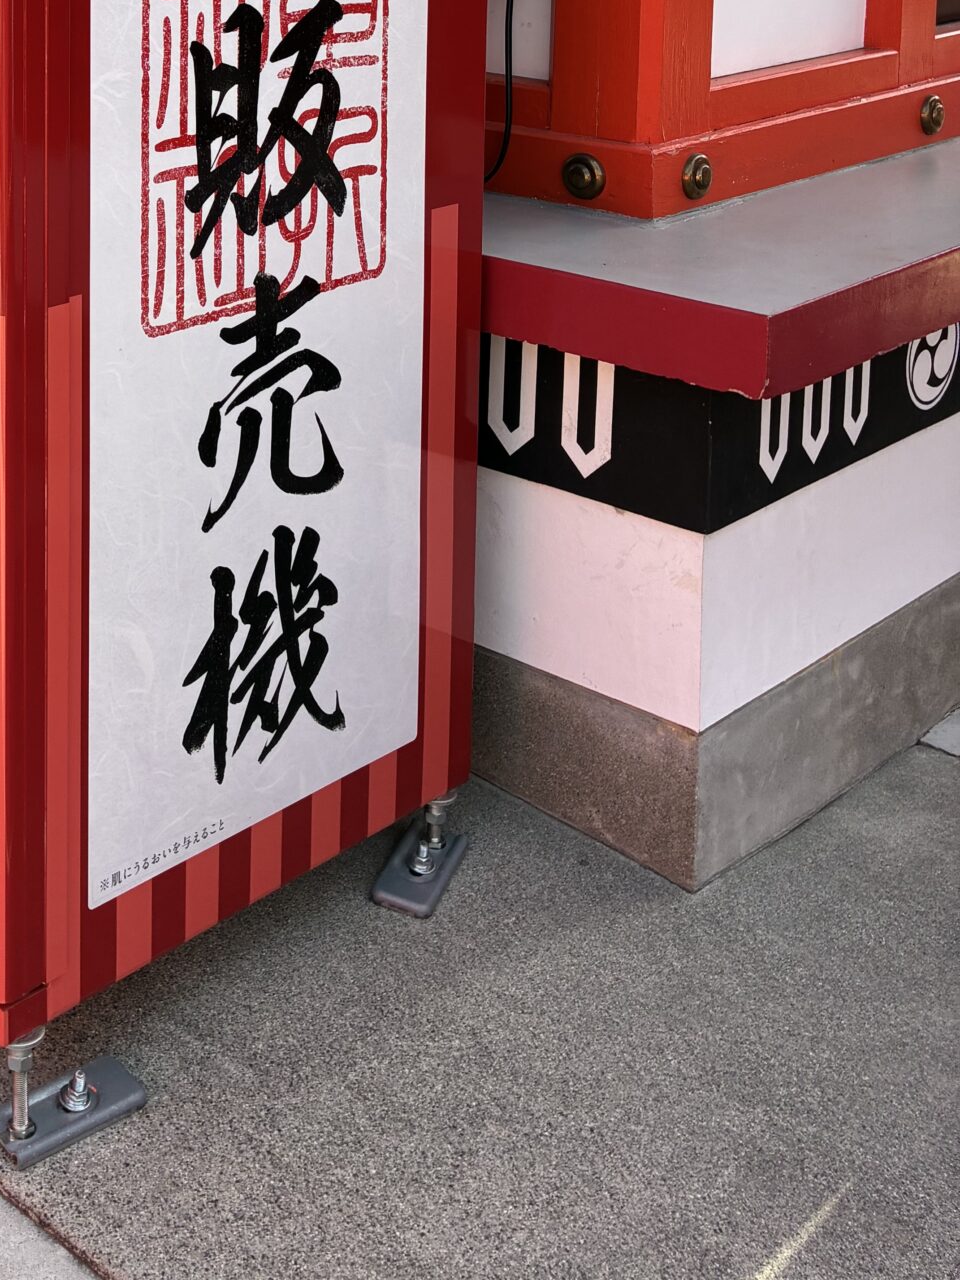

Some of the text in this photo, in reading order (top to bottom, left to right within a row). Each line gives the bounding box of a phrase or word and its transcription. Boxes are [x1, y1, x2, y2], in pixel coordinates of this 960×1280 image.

[100, 819, 225, 892] ※肌にうるおいを与えること
